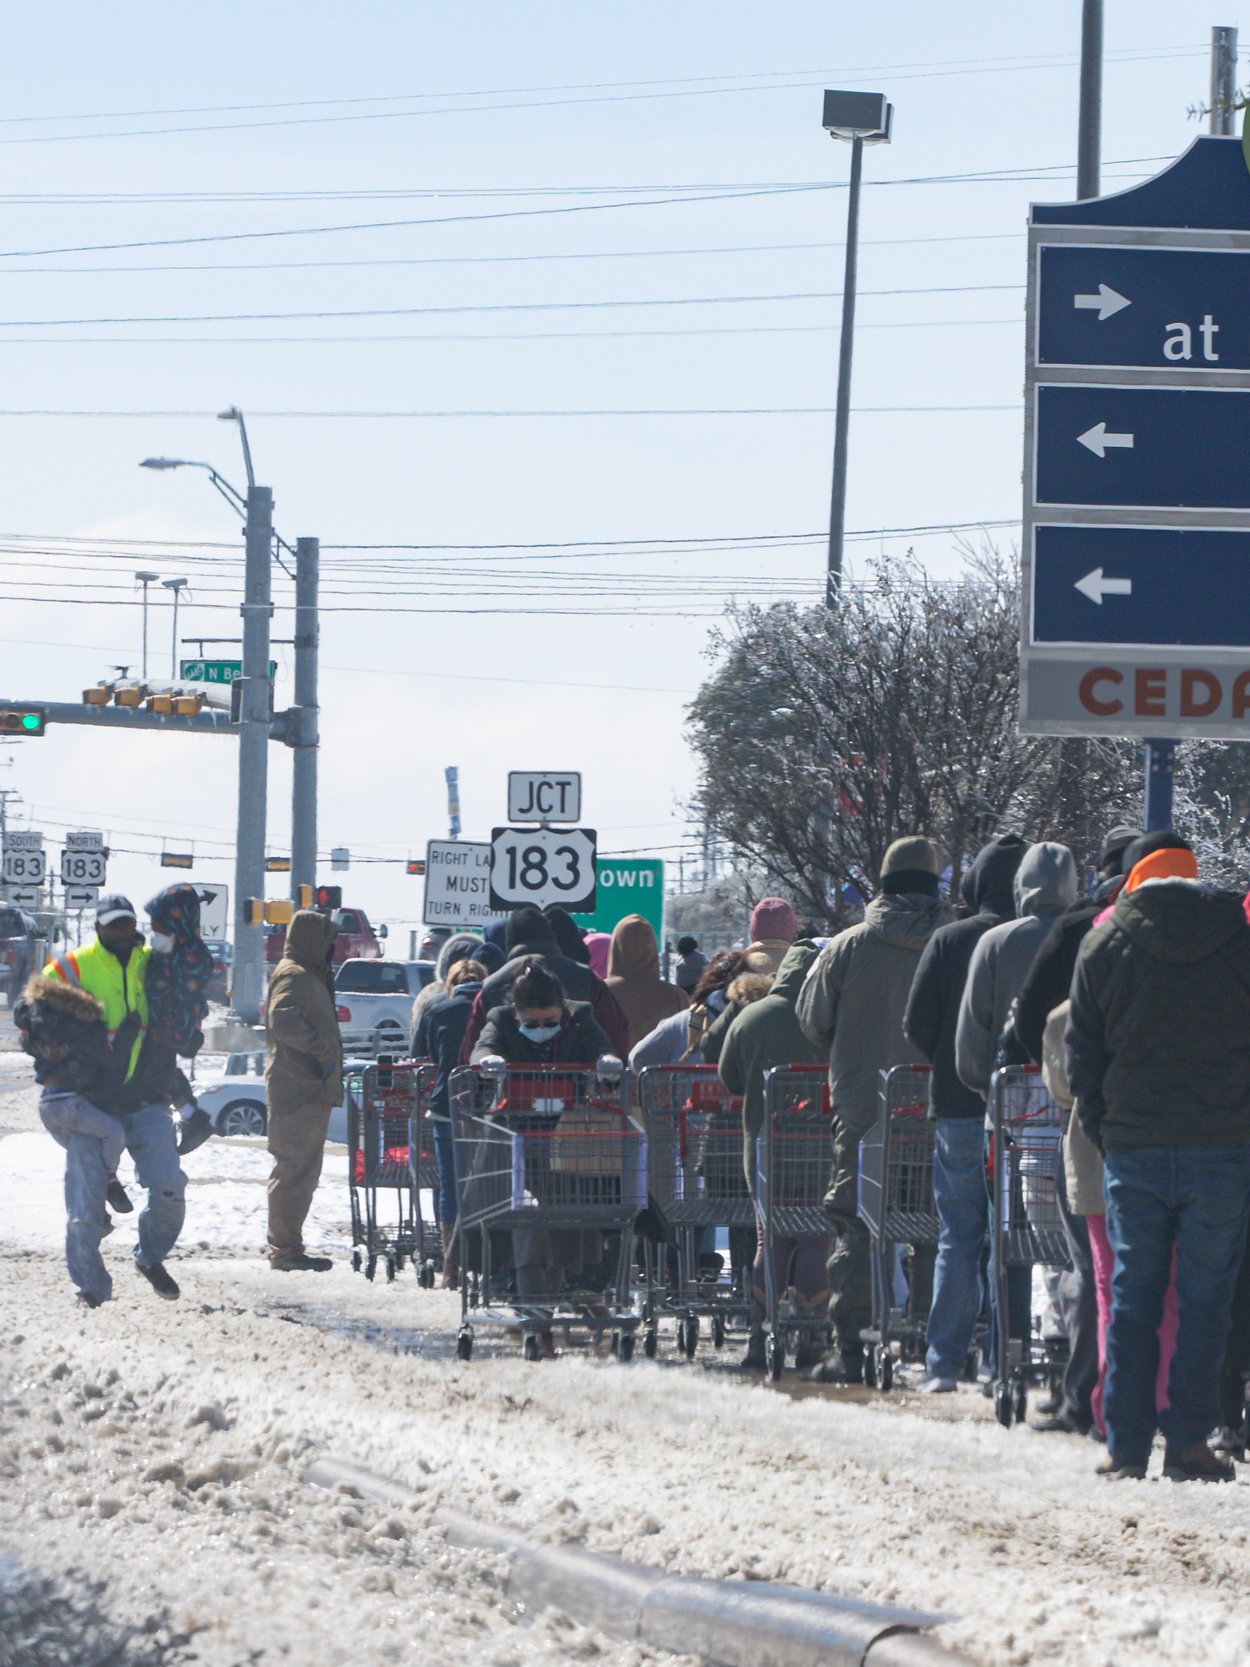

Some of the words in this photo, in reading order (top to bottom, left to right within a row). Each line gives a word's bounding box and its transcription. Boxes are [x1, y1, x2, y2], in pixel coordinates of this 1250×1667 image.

[1163, 315, 1220, 361] at
[209, 667, 218, 680] N
[517, 781, 572, 814] JCT
[9, 834, 41, 847] SOUTH
[68, 835, 101, 847] NORTH
[6, 857, 41, 877] 183
[431, 850, 469, 866] RIGHT
[65, 858, 101, 878] 183
[506, 846, 581, 891] 183
[446, 875, 489, 893] MUST
[428, 901, 461, 916] TURN
[469, 903, 504, 918] RIG
